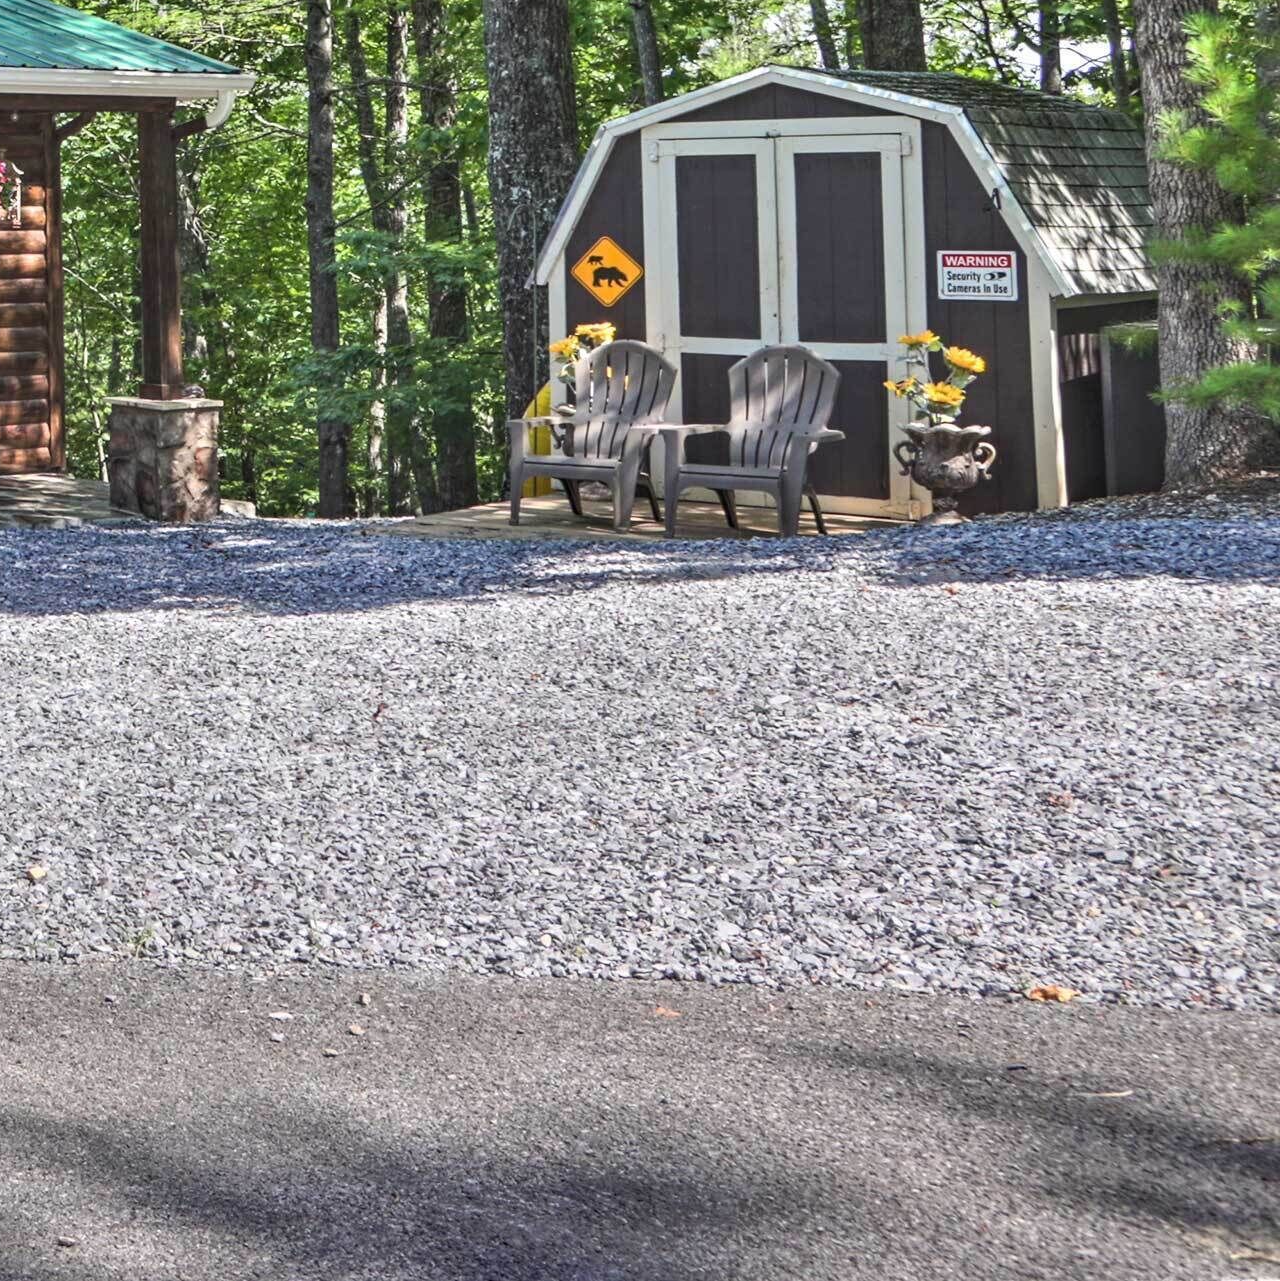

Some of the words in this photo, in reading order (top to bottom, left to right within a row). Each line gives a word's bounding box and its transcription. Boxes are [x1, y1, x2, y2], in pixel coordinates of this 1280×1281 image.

[944, 256, 1008, 267] WARNING
[947, 271, 981, 282] Security
[947, 283, 981, 293] Cameras
[983, 284, 991, 293] In
[993, 284, 1008, 294] Use
